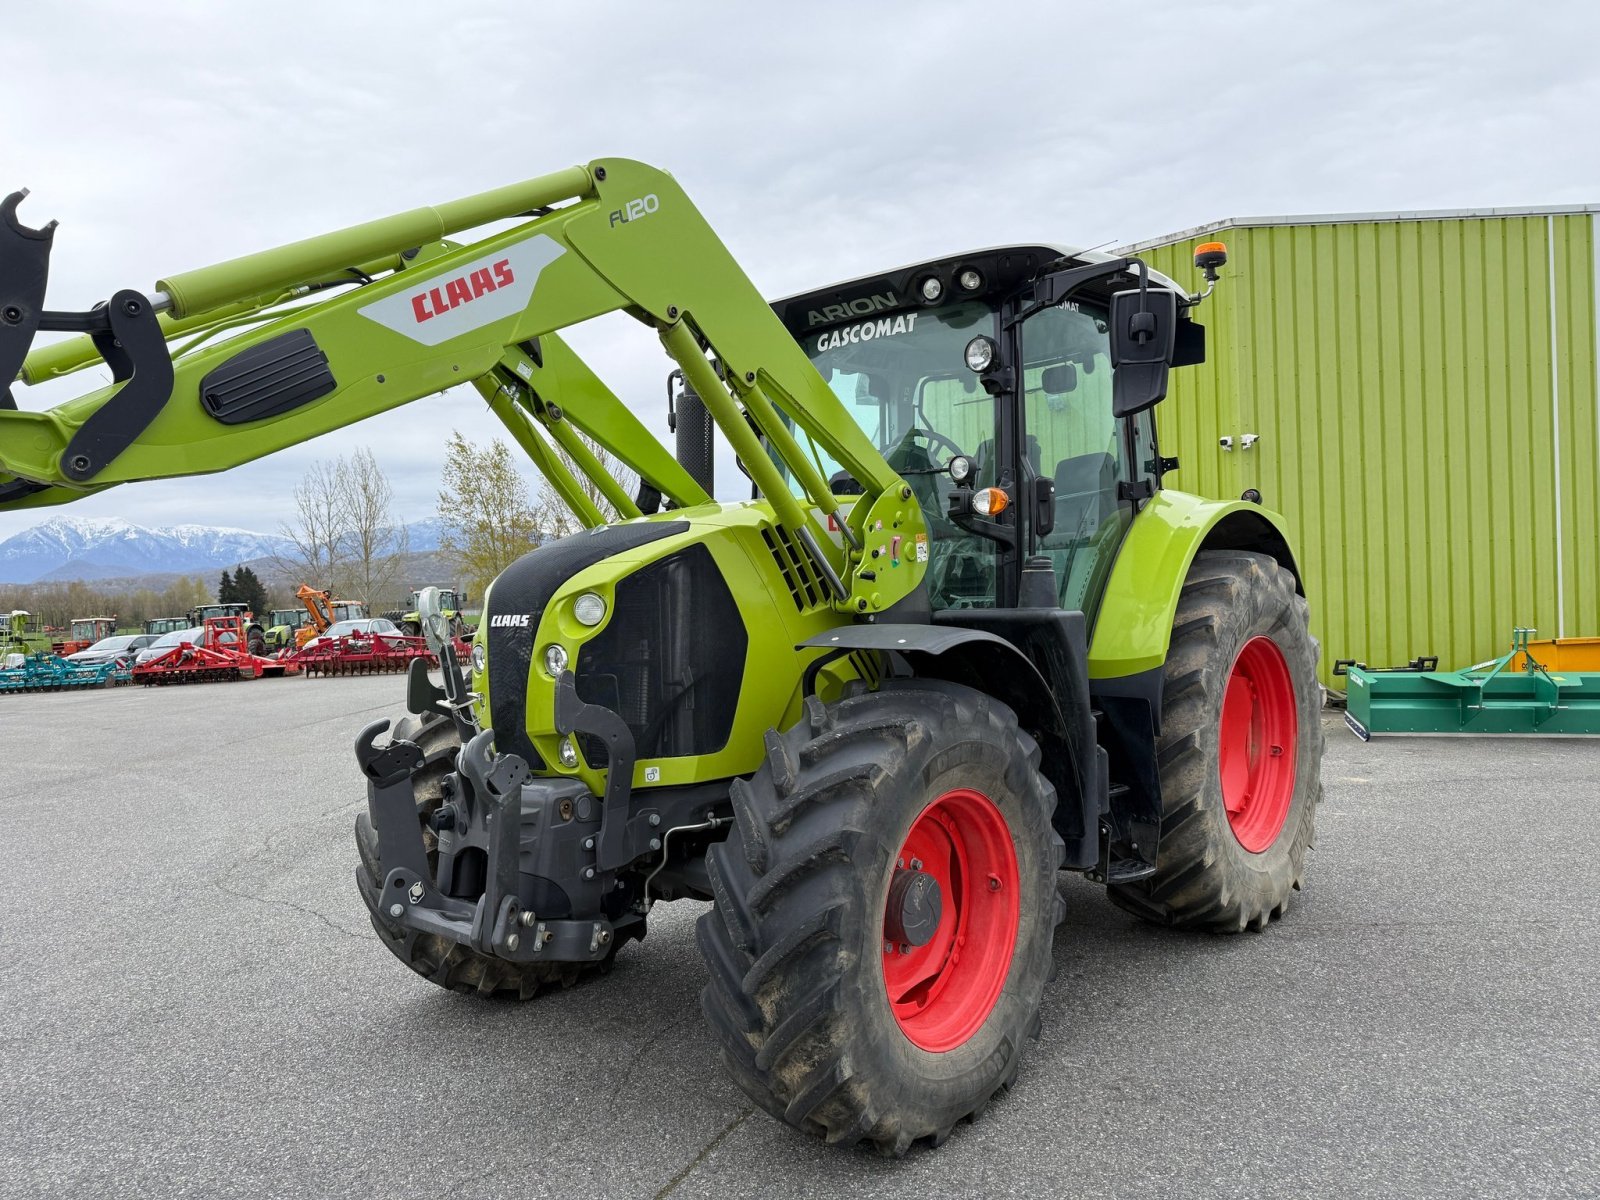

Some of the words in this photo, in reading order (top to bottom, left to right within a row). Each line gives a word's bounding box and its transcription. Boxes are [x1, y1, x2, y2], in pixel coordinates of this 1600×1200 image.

[609, 193, 659, 227] FL120
[411, 258, 514, 323] CLAAS
[808, 291, 899, 326] ARION
[817, 312, 918, 352] GASCOMAT
[490, 614, 529, 627] CLAAS
